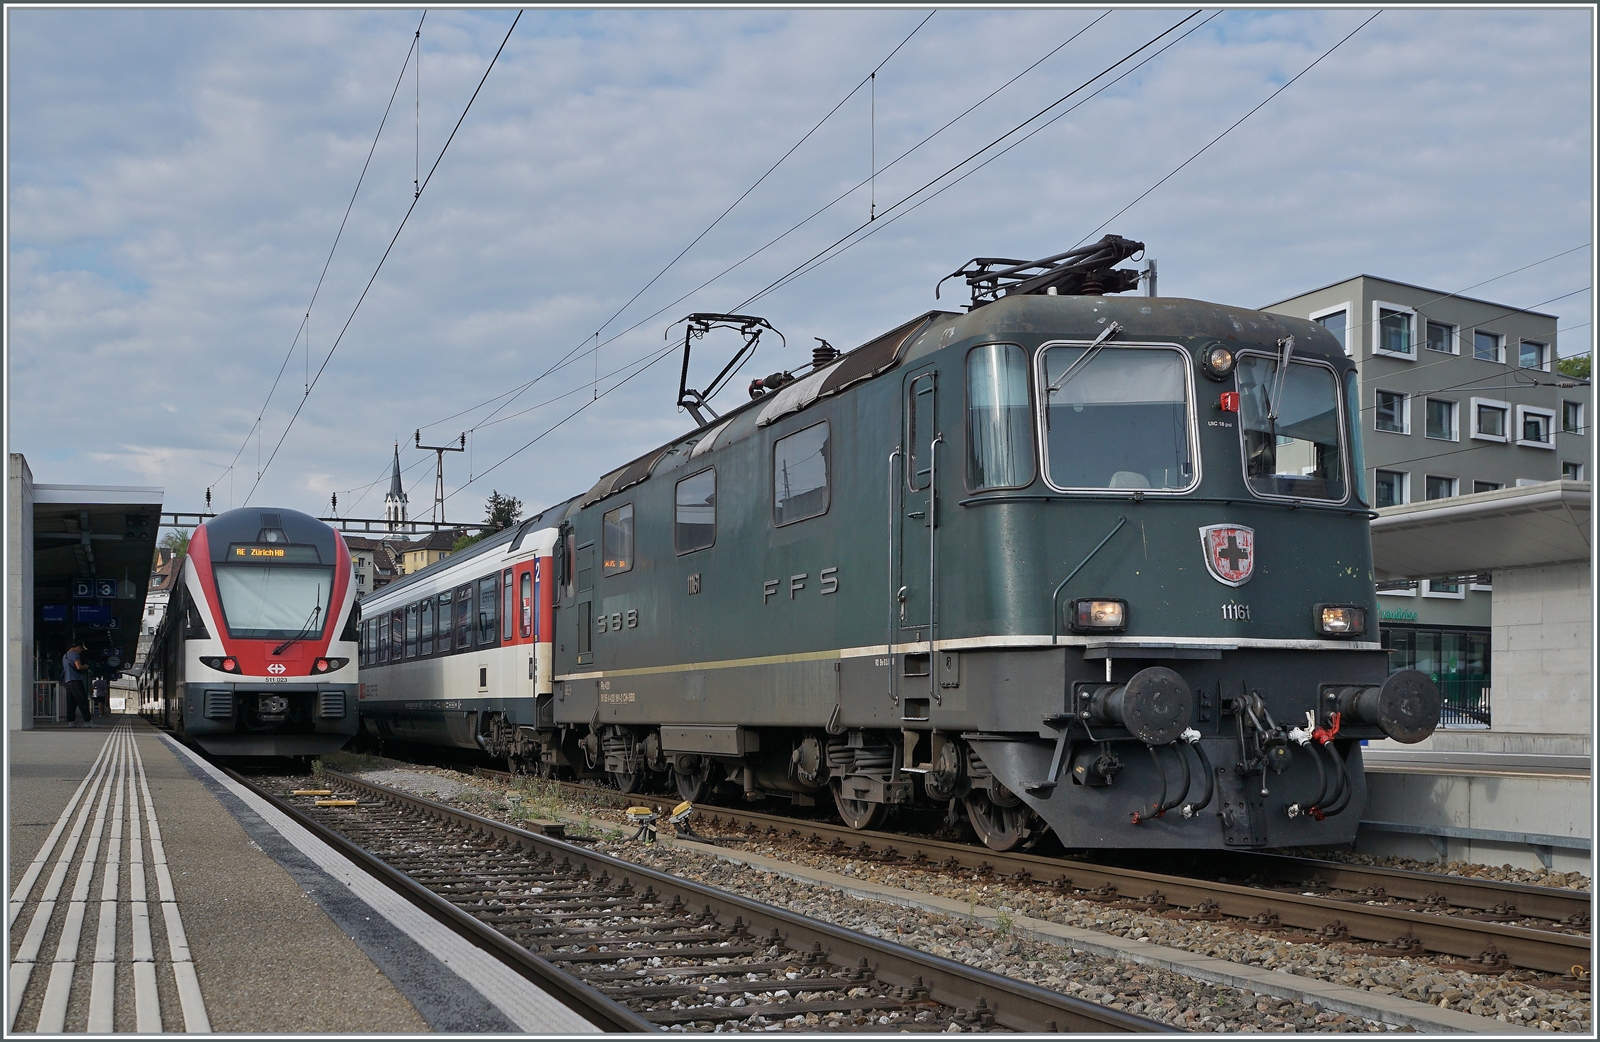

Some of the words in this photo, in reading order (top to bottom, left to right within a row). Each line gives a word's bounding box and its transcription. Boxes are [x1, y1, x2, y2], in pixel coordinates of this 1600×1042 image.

[236, 548, 246, 556] RE
[250, 548, 274, 556] Zürich
[274, 549, 285, 557] HB
[535, 561, 540, 583] 2
[78, 584, 88, 595] D
[101, 584, 111, 595] 3
[763, 566, 838, 605] FFS
[1221, 604, 1251, 620] 11161
[1381, 607, 1418, 620] vaudoise
[109, 619, 116, 628] 3
[597, 608, 638, 634] SBB
